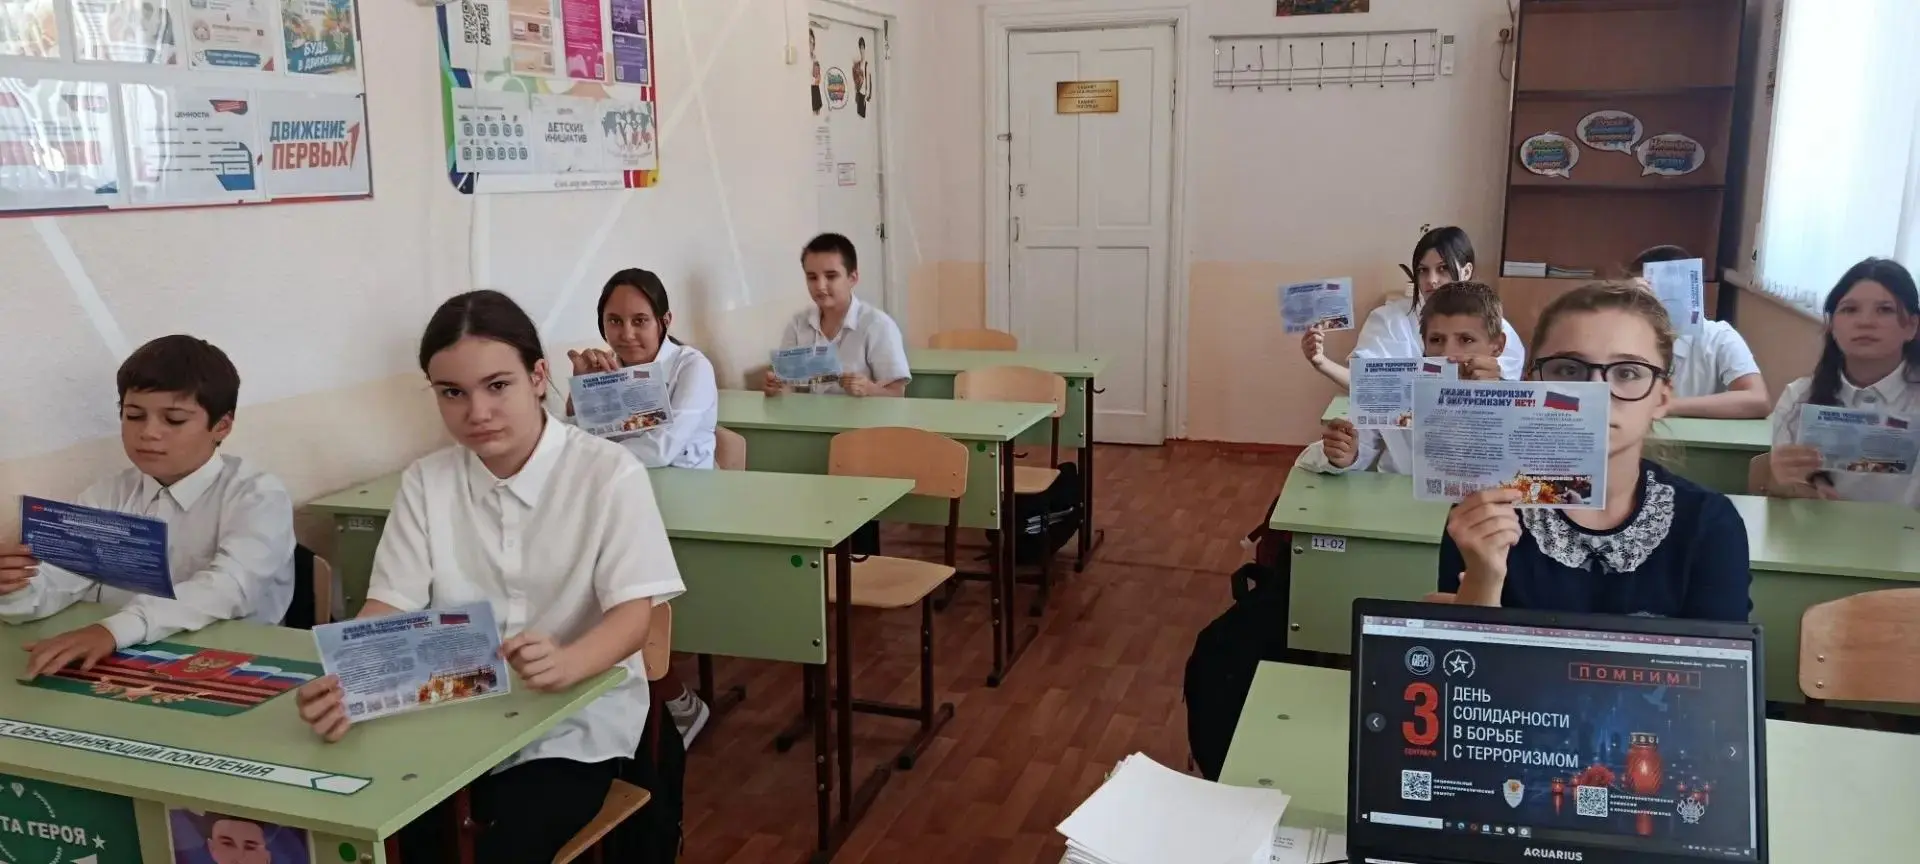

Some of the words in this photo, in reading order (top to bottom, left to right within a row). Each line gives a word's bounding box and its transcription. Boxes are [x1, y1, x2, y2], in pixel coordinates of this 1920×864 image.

[270, 120, 346, 142] ДВИЖЕНИЕ
[548, 122, 584, 132] ДЕТСКИХ
[545, 132, 587, 143] ИНИЦИАТИВ
[271, 141, 349, 171] ПЕРВЫХ
[1438, 396, 1444, 405] И
[1447, 397, 1512, 407] ЭКСТРЕМИЗМУ
[1514, 399, 1536, 407] НЕТ!
[1441, 388, 1471, 397] СКАЖИ
[1474, 389, 1534, 398] ТЕРРОРИЗМУ
[1313, 538, 1345, 549] 11-02
[1579, 666, 1690, 684] ПОМНИМ!
[1453, 686, 1491, 703] ДЕНЬ
[1402, 682, 1439, 745] 3
[1453, 705, 1569, 728] СОЛИДАРНОСТИ
[1453, 725, 1462, 739] В
[1467, 726, 1523, 744] БОРЬБЕ
[11, 726, 165, 758] ОБЪЕДИНЯЮЩИЙ
[160, 751, 276, 777] ПОКОЛЕНИЯ
[1453, 744, 1462, 758] С
[1466, 745, 1578, 768] ТЕРРОРИЗМОМ
[27, 821, 87, 846] ГЕРОЯ
[1523, 847, 1583, 861] AQUARIUS
